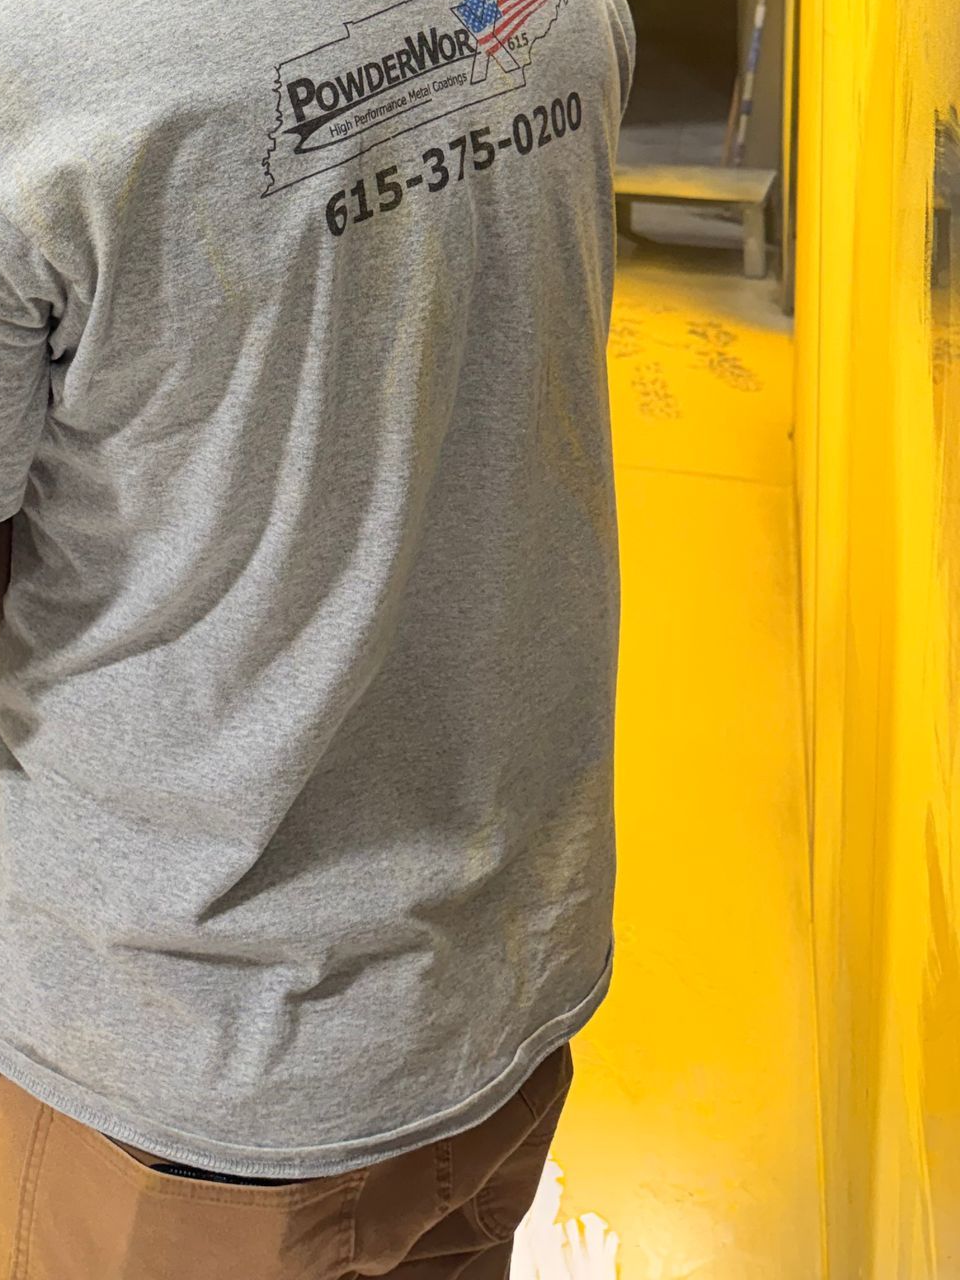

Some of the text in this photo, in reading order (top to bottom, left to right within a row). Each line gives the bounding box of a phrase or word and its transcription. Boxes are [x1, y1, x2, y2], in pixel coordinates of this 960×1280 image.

[507, 32, 529, 51] 615
[329, 71, 468, 137] High Performance Metal Coatings
[325, 91, 582, 237] 615-375-0200
